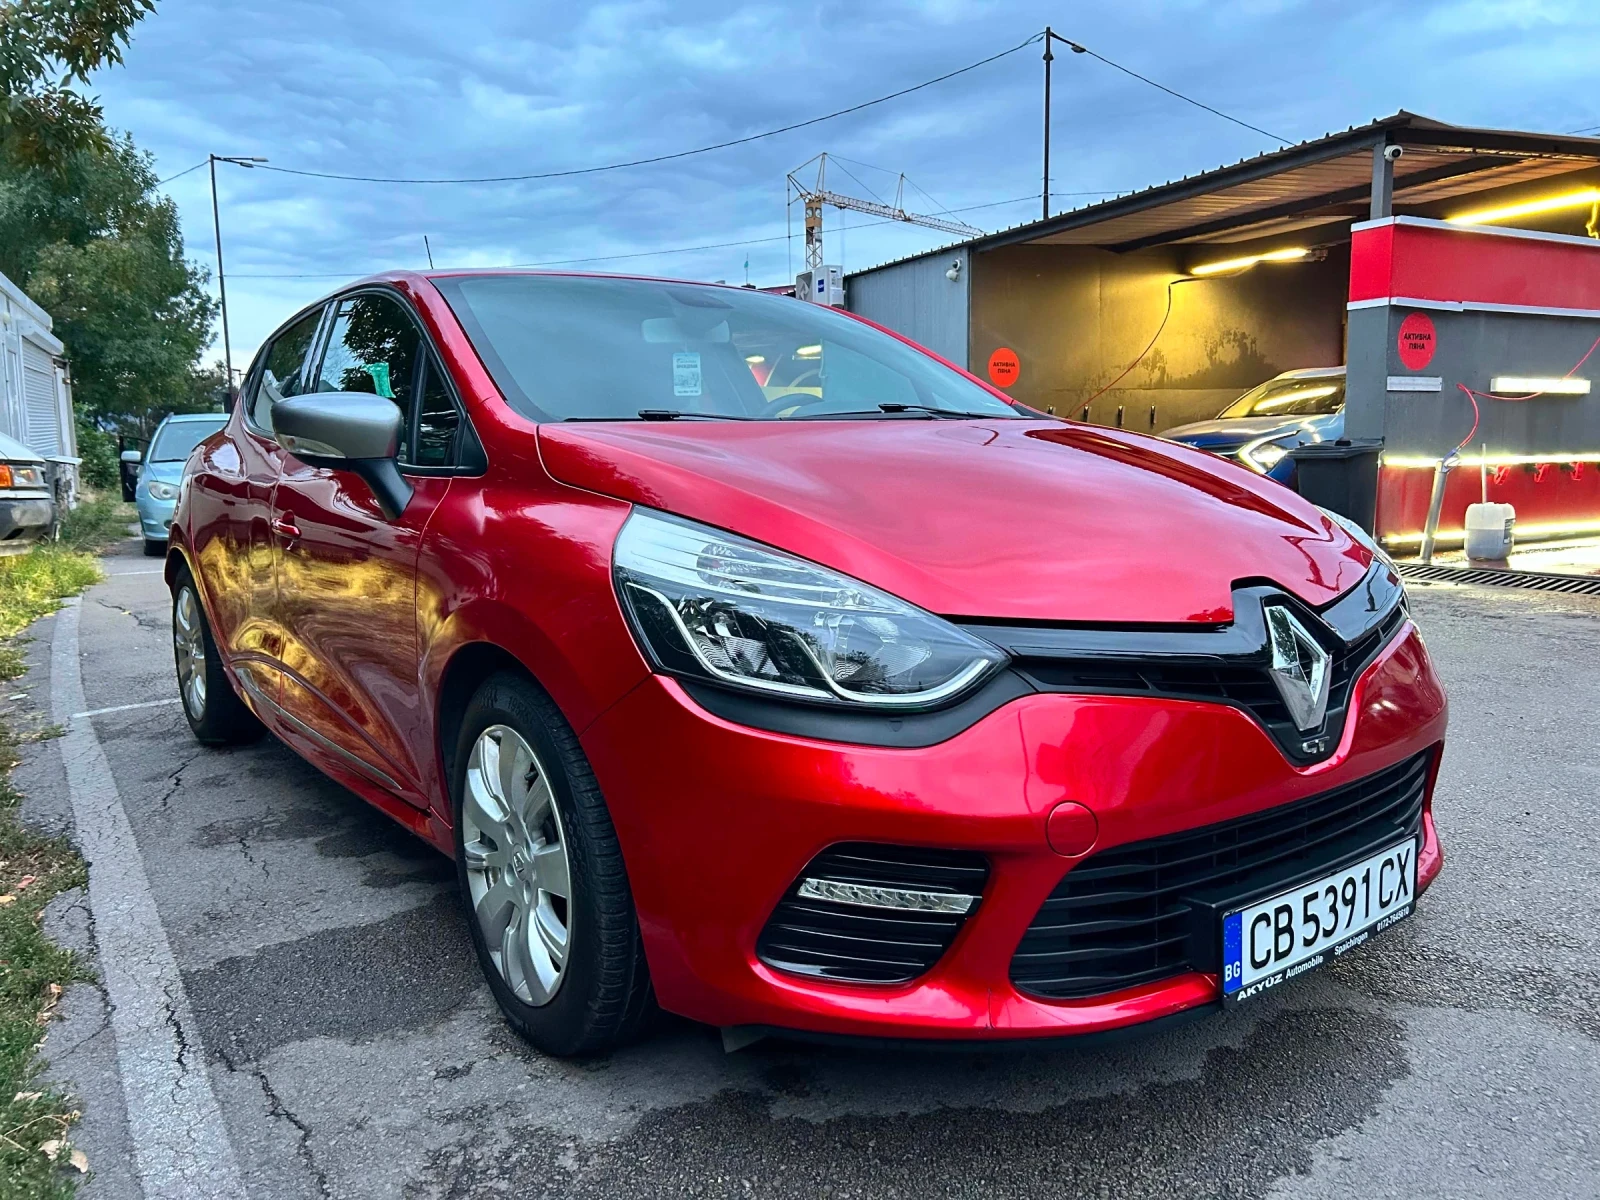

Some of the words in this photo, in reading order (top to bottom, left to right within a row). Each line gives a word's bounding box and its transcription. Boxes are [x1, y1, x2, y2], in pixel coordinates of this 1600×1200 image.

[1224, 960, 1241, 982] BG
[1236, 973, 1283, 1001] AKYÜZ
[1285, 954, 1324, 979] Automobile
[1334, 931, 1368, 956] Spaichingen
